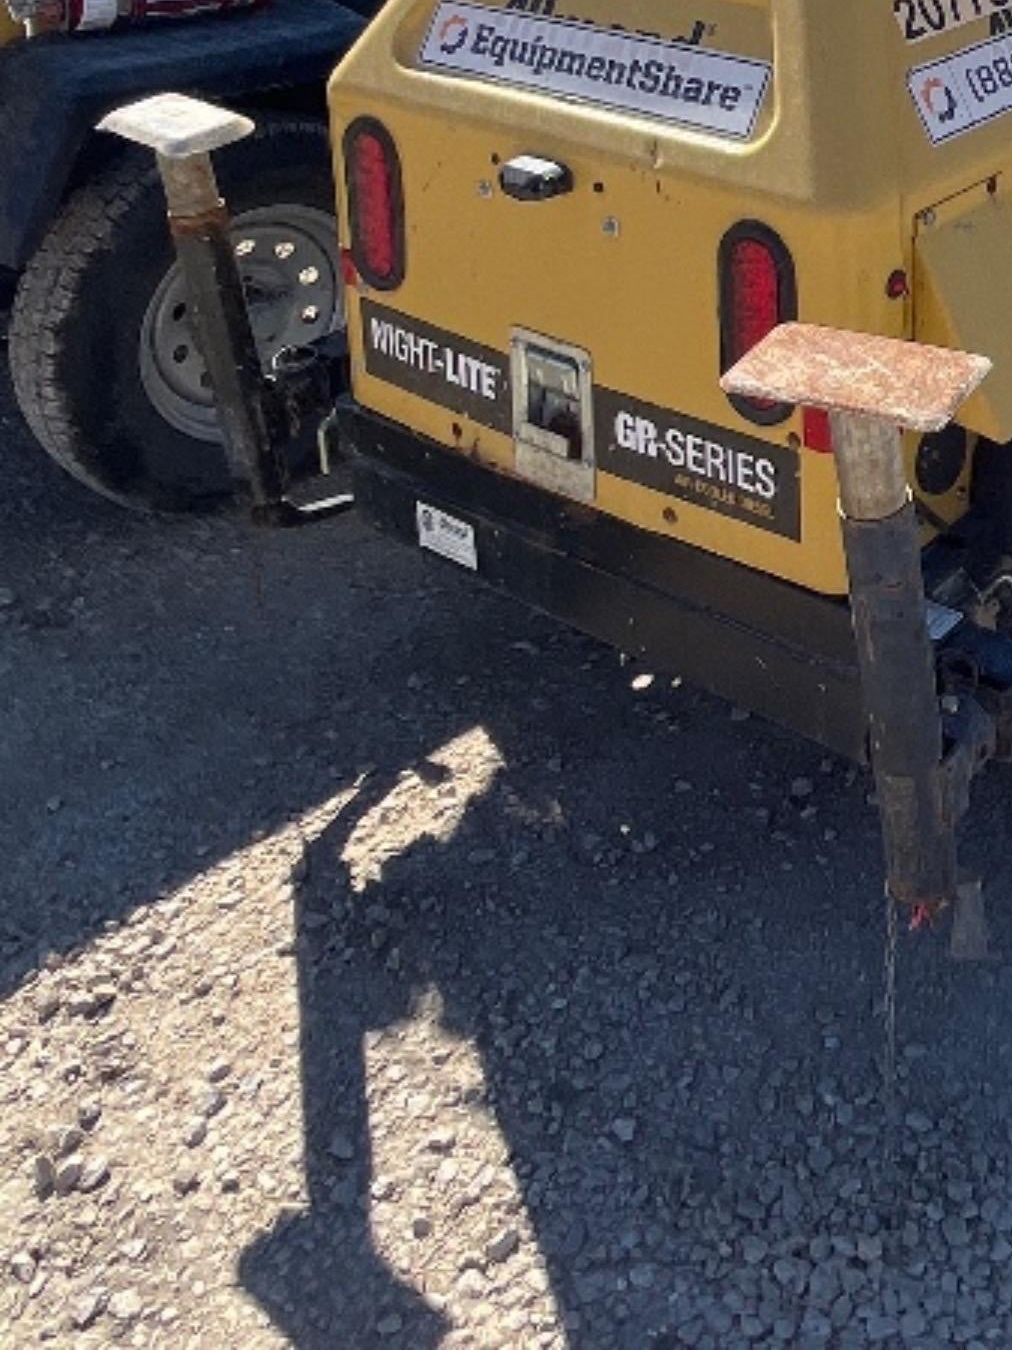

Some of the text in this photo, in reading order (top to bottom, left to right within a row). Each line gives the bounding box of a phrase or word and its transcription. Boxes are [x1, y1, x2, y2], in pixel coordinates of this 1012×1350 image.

[470, 23, 742, 112] EquipmentShare
[370, 317, 497, 401] NIGHT-LITE
[614, 410, 777, 500] GR-SERIES
